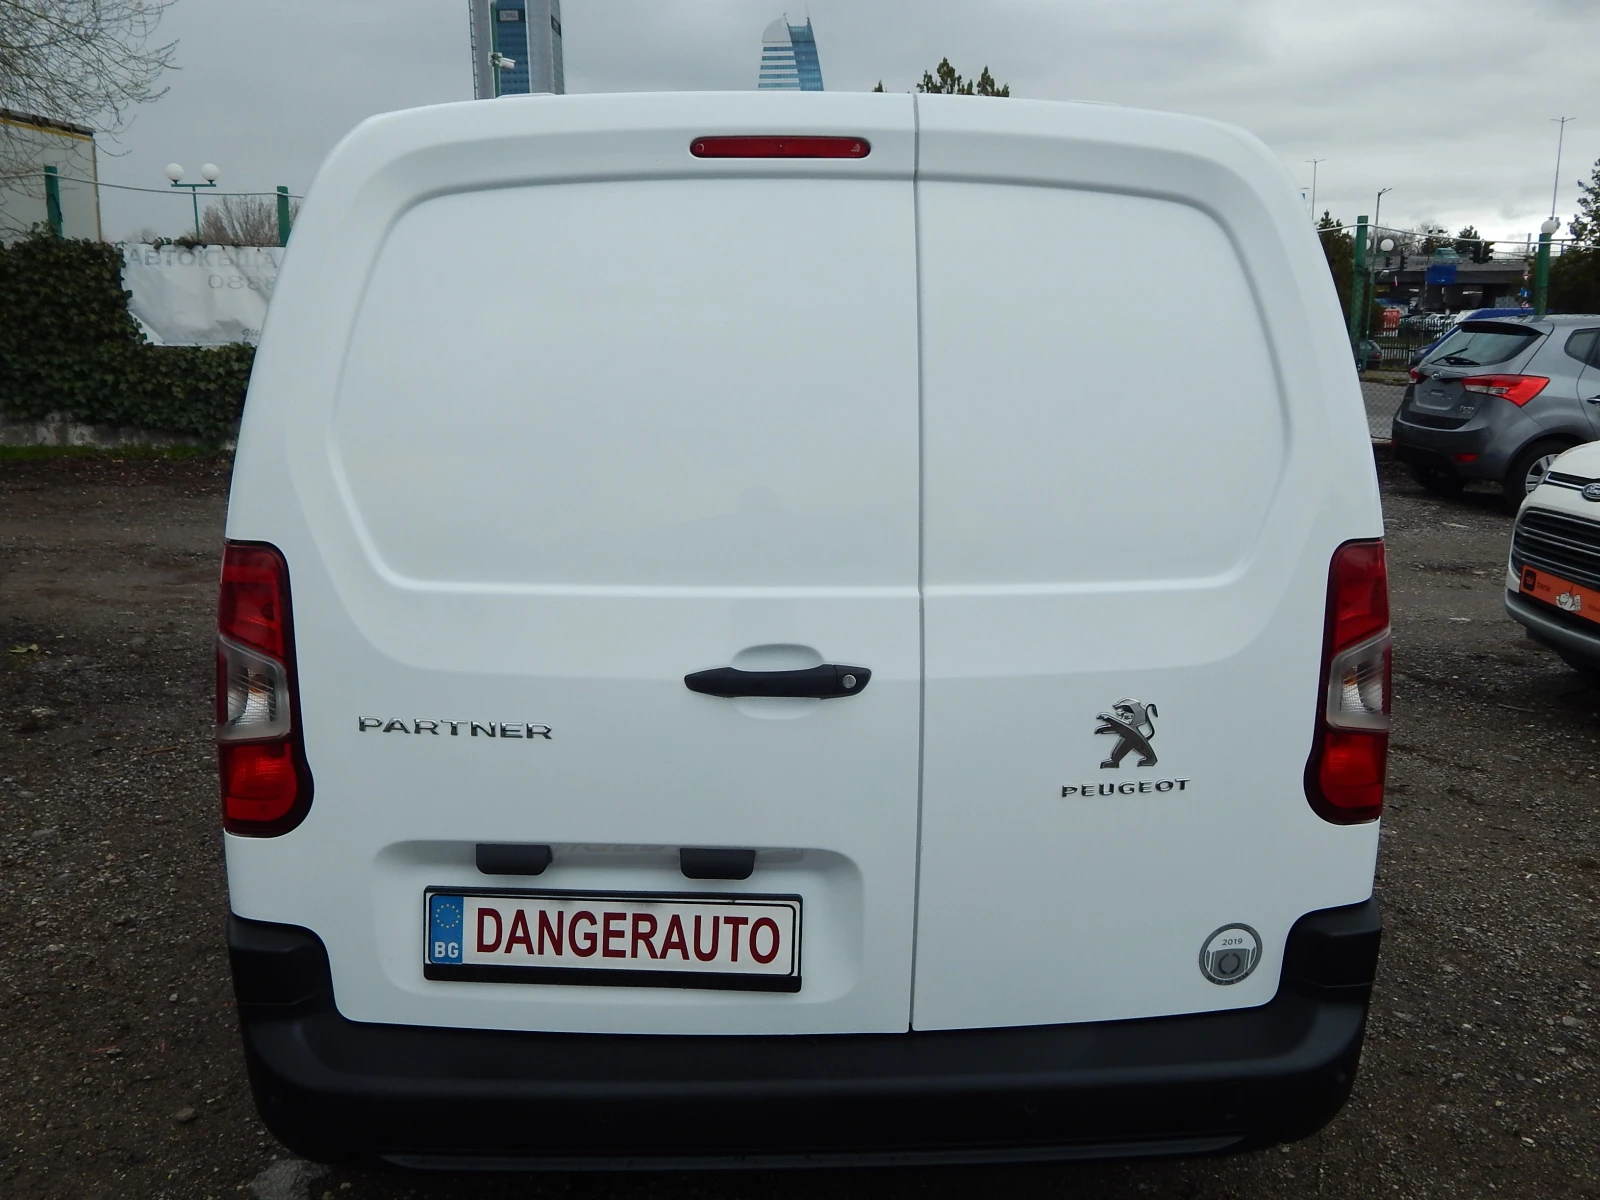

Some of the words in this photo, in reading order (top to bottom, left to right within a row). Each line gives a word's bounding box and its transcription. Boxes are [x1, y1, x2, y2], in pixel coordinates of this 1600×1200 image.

[358, 716, 553, 740] PARTNER
[1061, 777, 1191, 798] PEUGEOT
[476, 907, 780, 964] DANGERAUTO
[1222, 938, 1243, 946] 2019
[434, 942, 459, 959] BG
